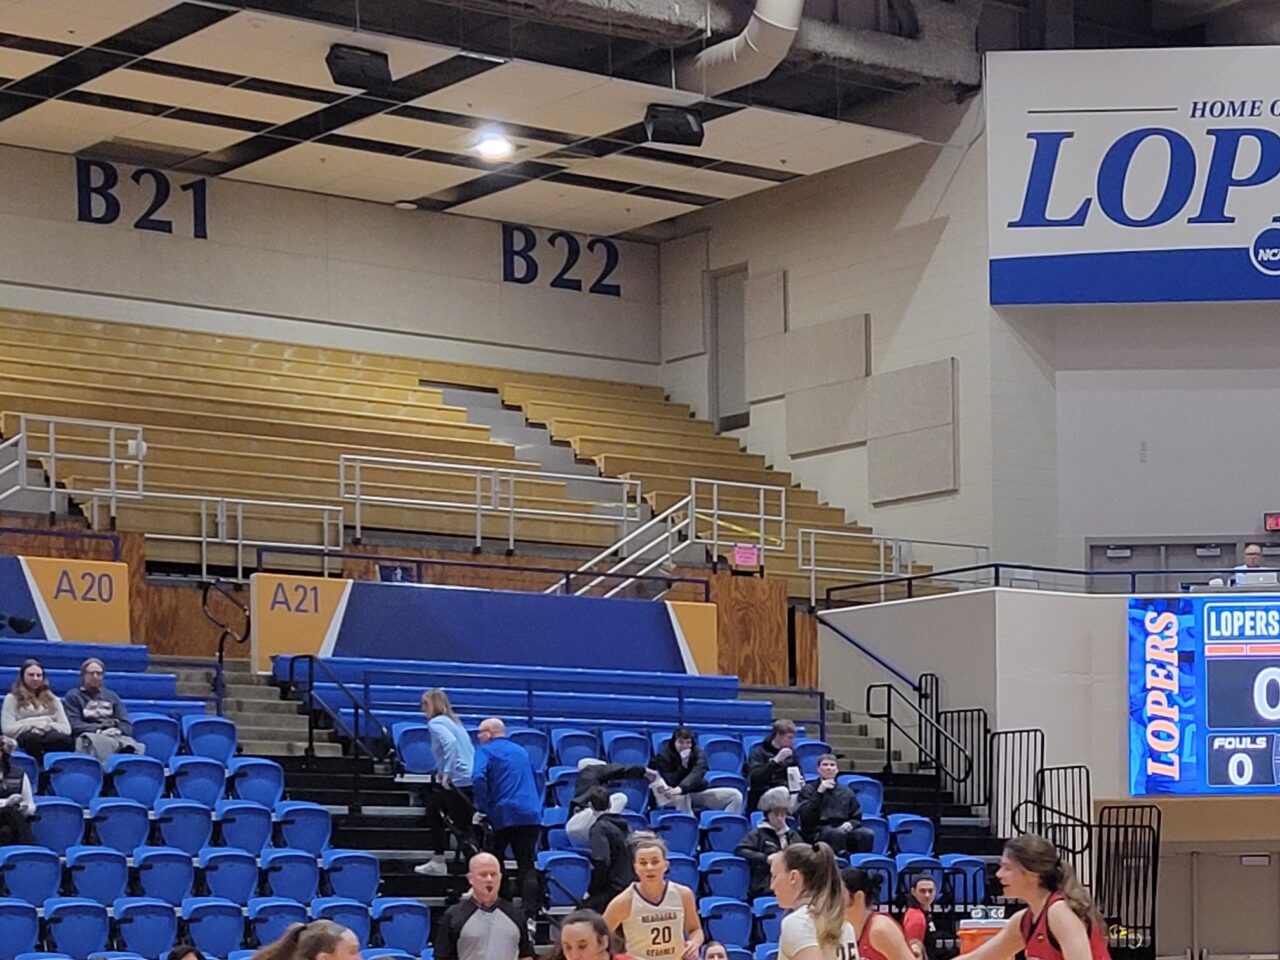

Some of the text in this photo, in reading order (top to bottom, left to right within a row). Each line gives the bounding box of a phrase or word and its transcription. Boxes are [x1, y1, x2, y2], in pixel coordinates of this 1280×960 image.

[1189, 100, 1263, 119] HOME
[75, 156, 208, 240] B21
[500, 223, 622, 297] B22
[54, 570, 114, 603] A20
[269, 582, 319, 613] A21
[1209, 610, 1280, 637] LOPERS
[1144, 611, 1181, 781] LOPERS
[1213, 736, 1268, 750] FOULS
[1227, 752, 1254, 786] 0
[651, 926, 672, 945] 20
